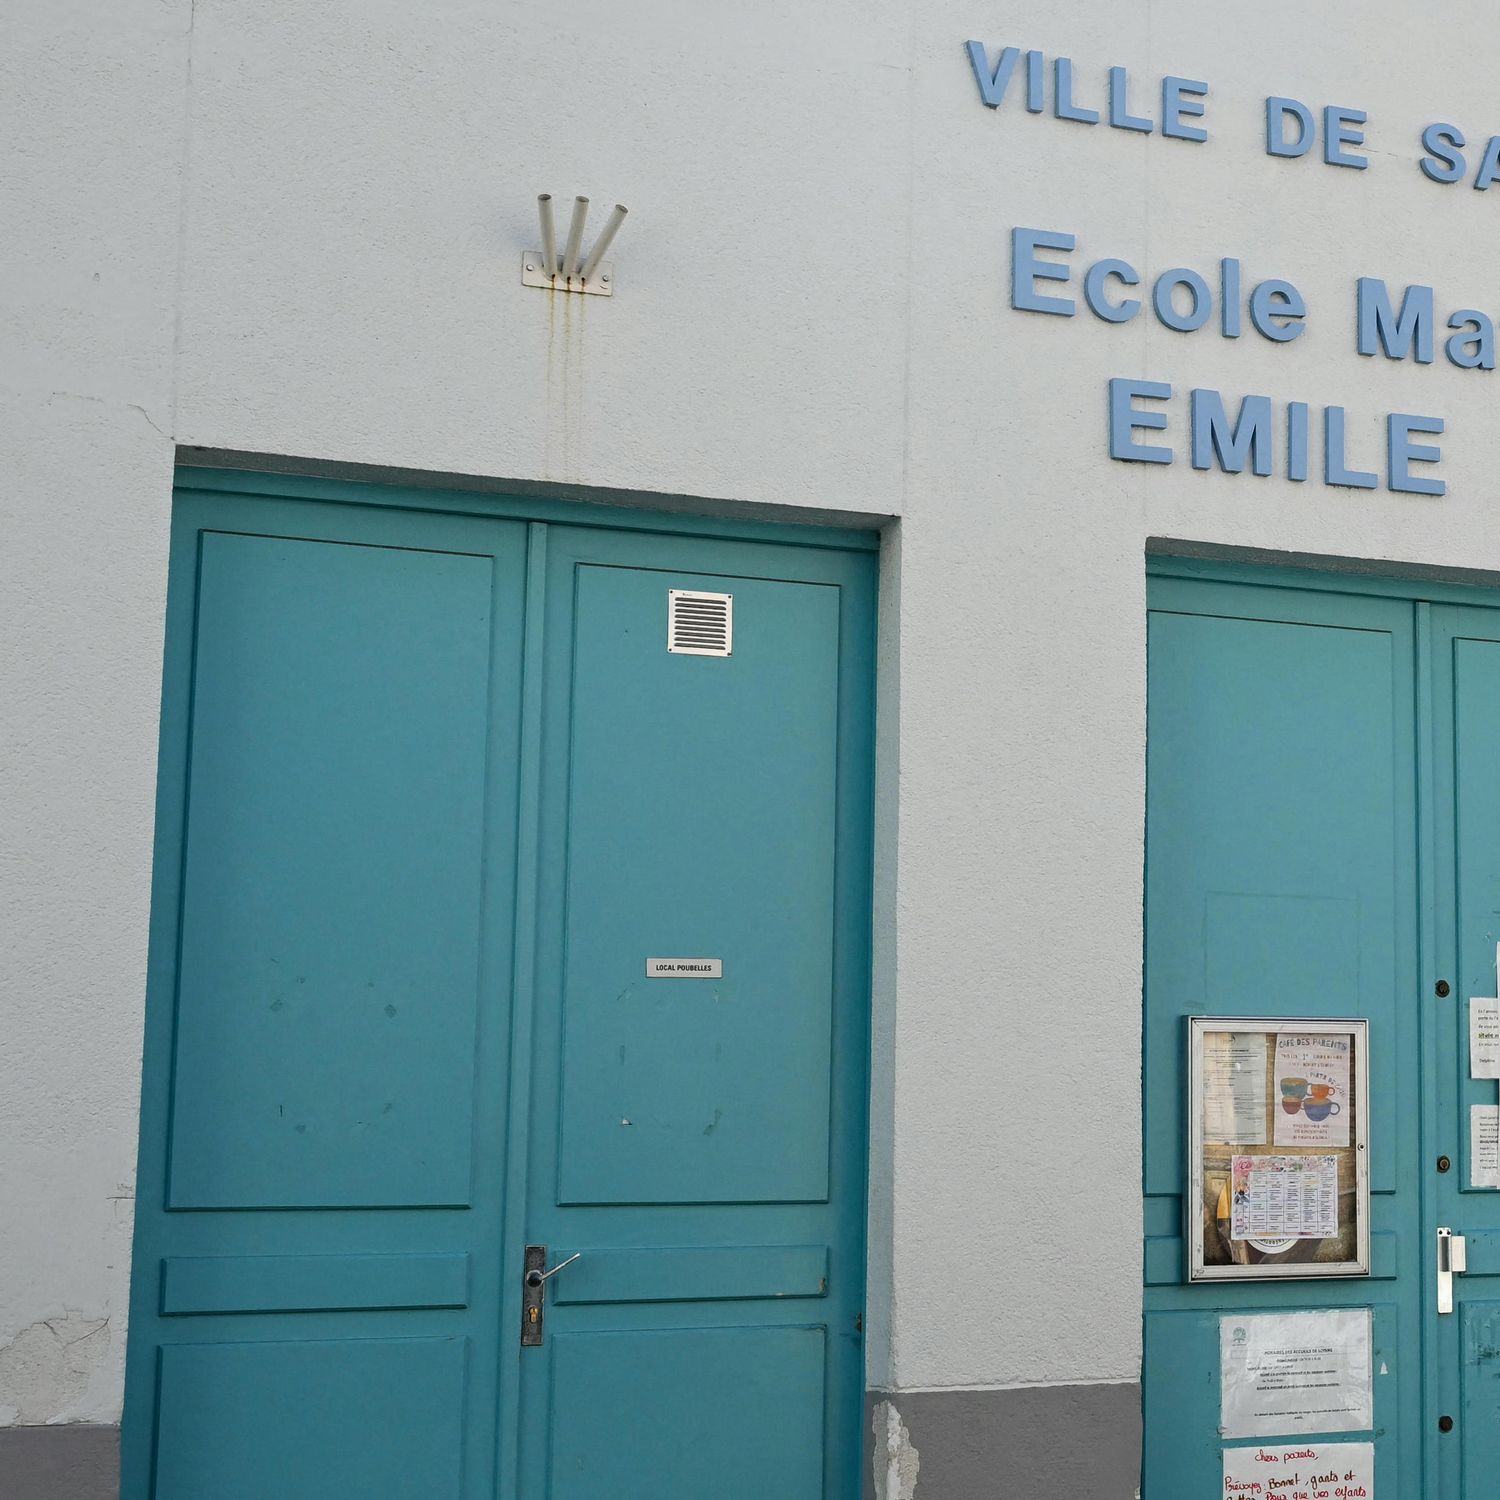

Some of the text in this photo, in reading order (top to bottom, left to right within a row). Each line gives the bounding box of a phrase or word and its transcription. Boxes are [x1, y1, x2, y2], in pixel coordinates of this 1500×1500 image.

[965, 39, 1209, 143] VILLE
[1265, 96, 1369, 171] DE
[1010, 226, 1307, 343] Ecole
[1107, 376, 1446, 497] EMILE
[677, 964, 712, 972] POUBELLES
[1296, 1038, 1310, 1046] DES
[1344, 1470, 1357, 1481] et
